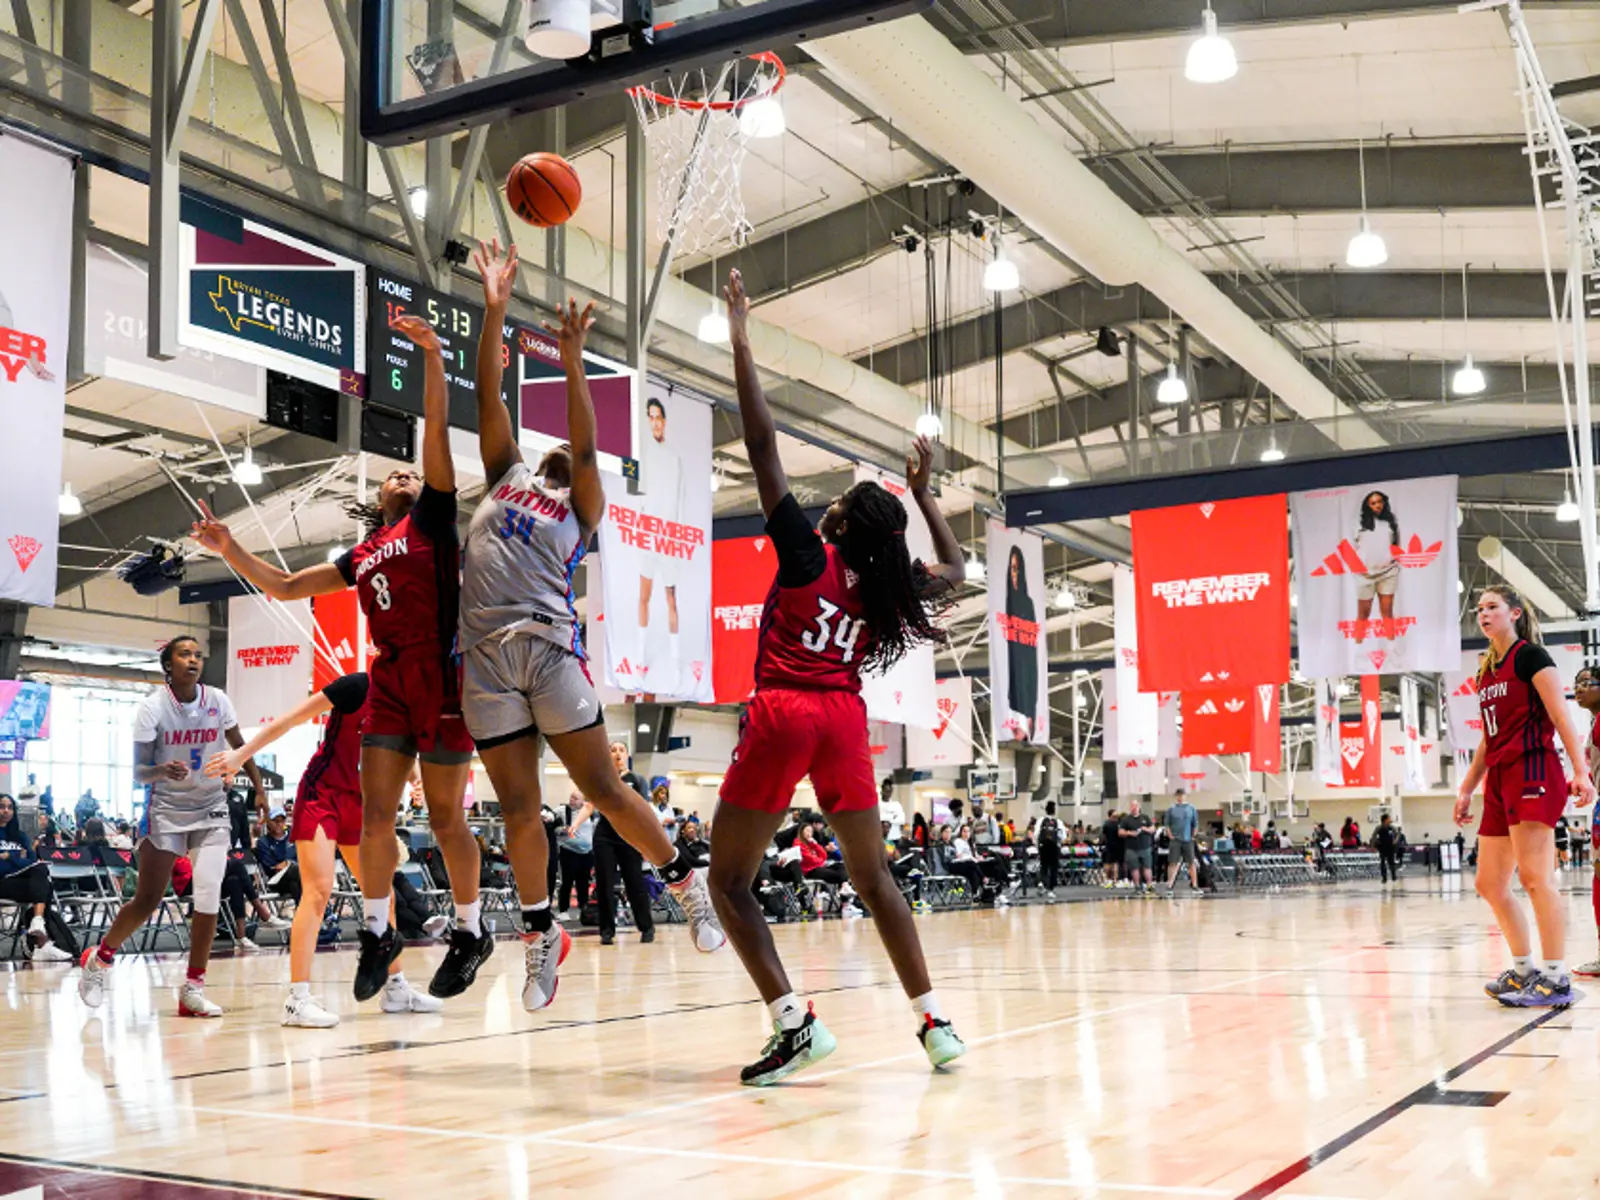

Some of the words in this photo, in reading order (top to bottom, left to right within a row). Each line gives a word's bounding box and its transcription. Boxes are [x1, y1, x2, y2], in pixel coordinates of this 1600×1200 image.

[378, 277, 412, 302] HOME
[237, 291, 342, 346] LEGENDS
[427, 298, 471, 337] 5:13
[458, 350, 465, 370] 1
[391, 369, 403, 391] 6
[499, 507, 538, 546] 34
[608, 503, 705, 546] REMEMBER
[617, 524, 652, 551] THE
[654, 535, 696, 561] WHY
[370, 572, 392, 611] 8
[1151, 572, 1270, 597] REMEMBER
[1163, 592, 1204, 609] THE
[1205, 585, 1260, 605] WHY
[723, 616, 754, 631] THE
[800, 595, 867, 664] 34
[237, 644, 300, 660] REMEMBER
[243, 656, 264, 668] THE
[265, 654, 293, 666] WHY
[189, 747, 202, 771] 5
